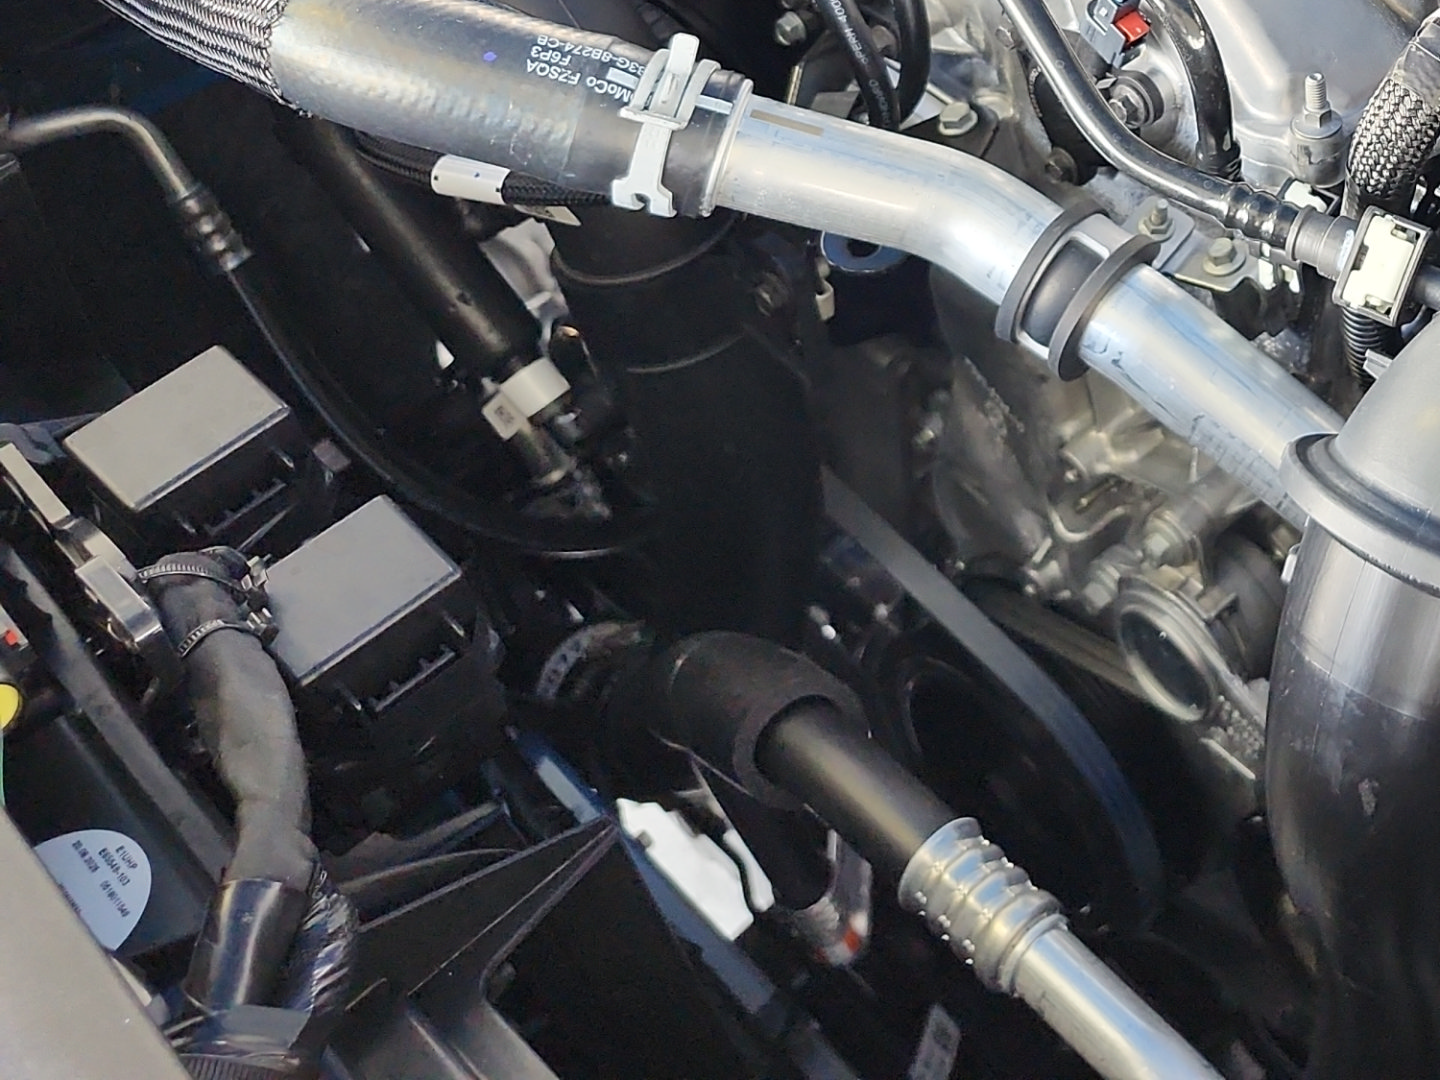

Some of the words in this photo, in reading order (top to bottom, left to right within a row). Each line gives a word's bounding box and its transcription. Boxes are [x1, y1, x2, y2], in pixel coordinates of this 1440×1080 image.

[530, 45, 572, 67] F6P3
[537, 34, 647, 76] B3G-8B274-CB
[526, 59, 581, 86] FZSQA
[586, 76, 636, 103] MoCo
